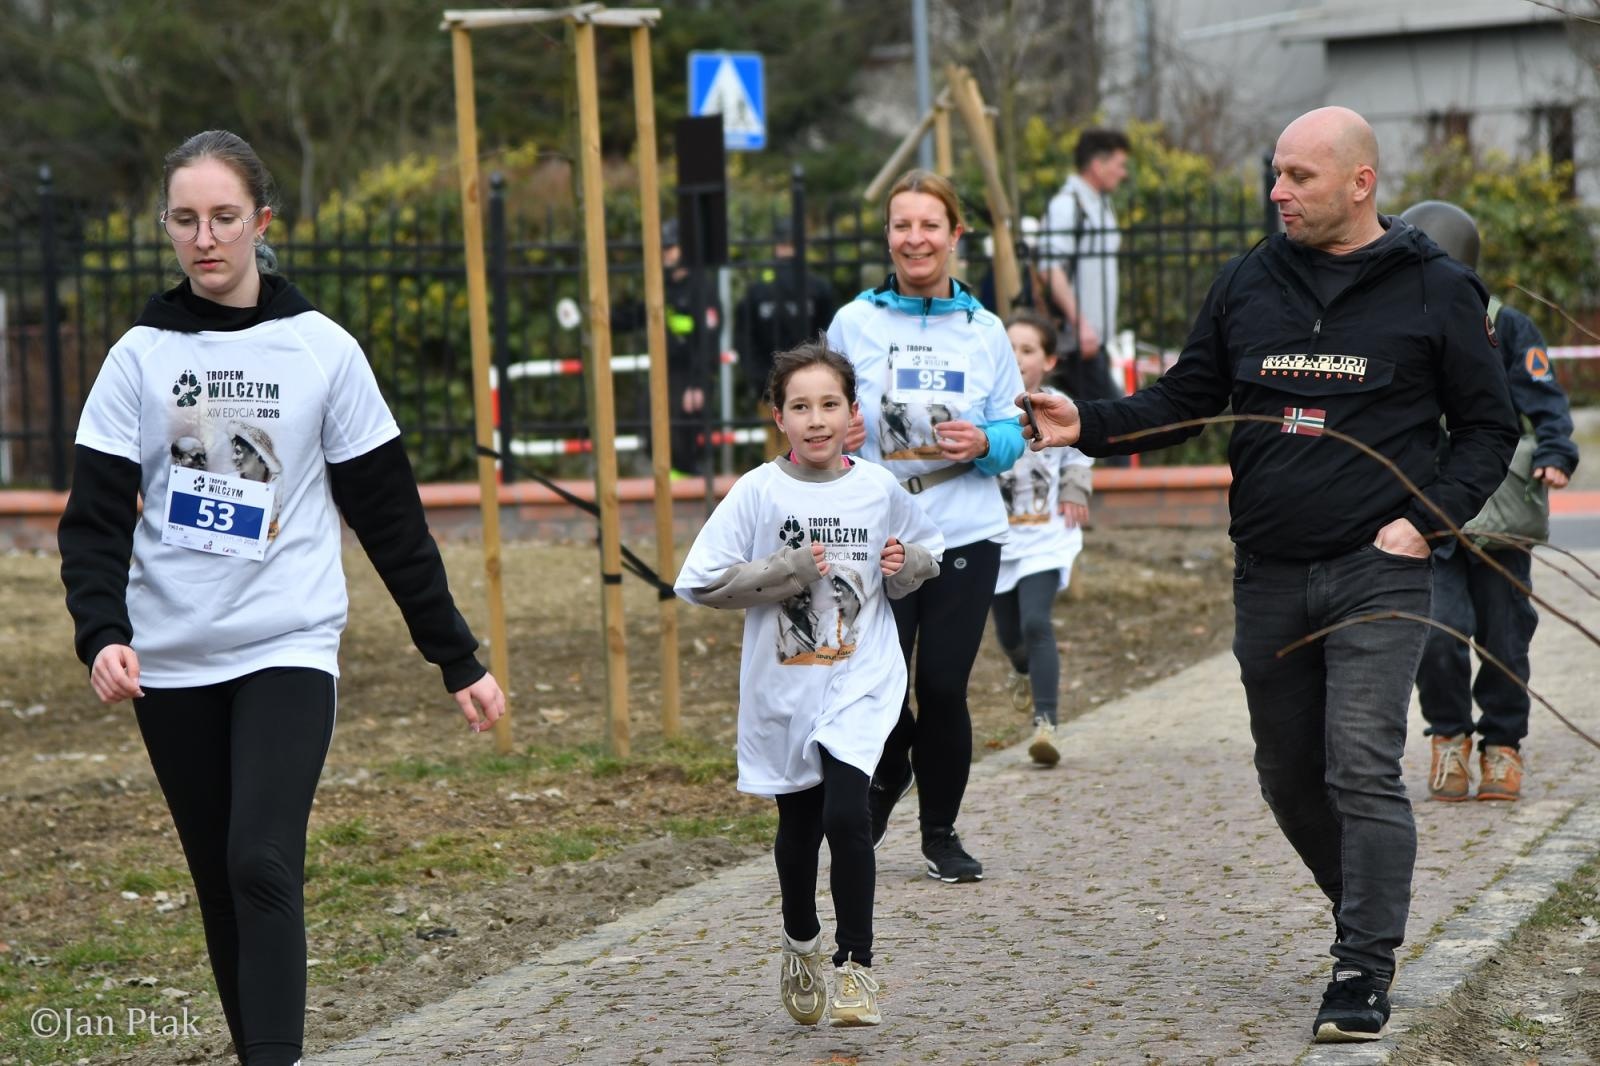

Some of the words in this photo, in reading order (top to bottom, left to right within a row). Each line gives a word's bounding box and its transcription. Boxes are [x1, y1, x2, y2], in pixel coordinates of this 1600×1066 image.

[1263, 354, 1367, 375] NAPAPIJRI
[206, 370, 244, 381] TROPEM
[918, 370, 947, 390] 95
[207, 382, 279, 399] WILCZYM
[207, 407, 222, 418] XIV
[222, 407, 256, 419] EDYCJA
[257, 408, 280, 419] 2026
[209, 477, 228, 486] TROPEM
[208, 484, 244, 498] WILCZYM
[196, 498, 235, 532] 53
[808, 517, 841, 527] TROPEM
[809, 528, 868, 543] WILCZYM
[824, 551, 851, 561] EDYCJA
